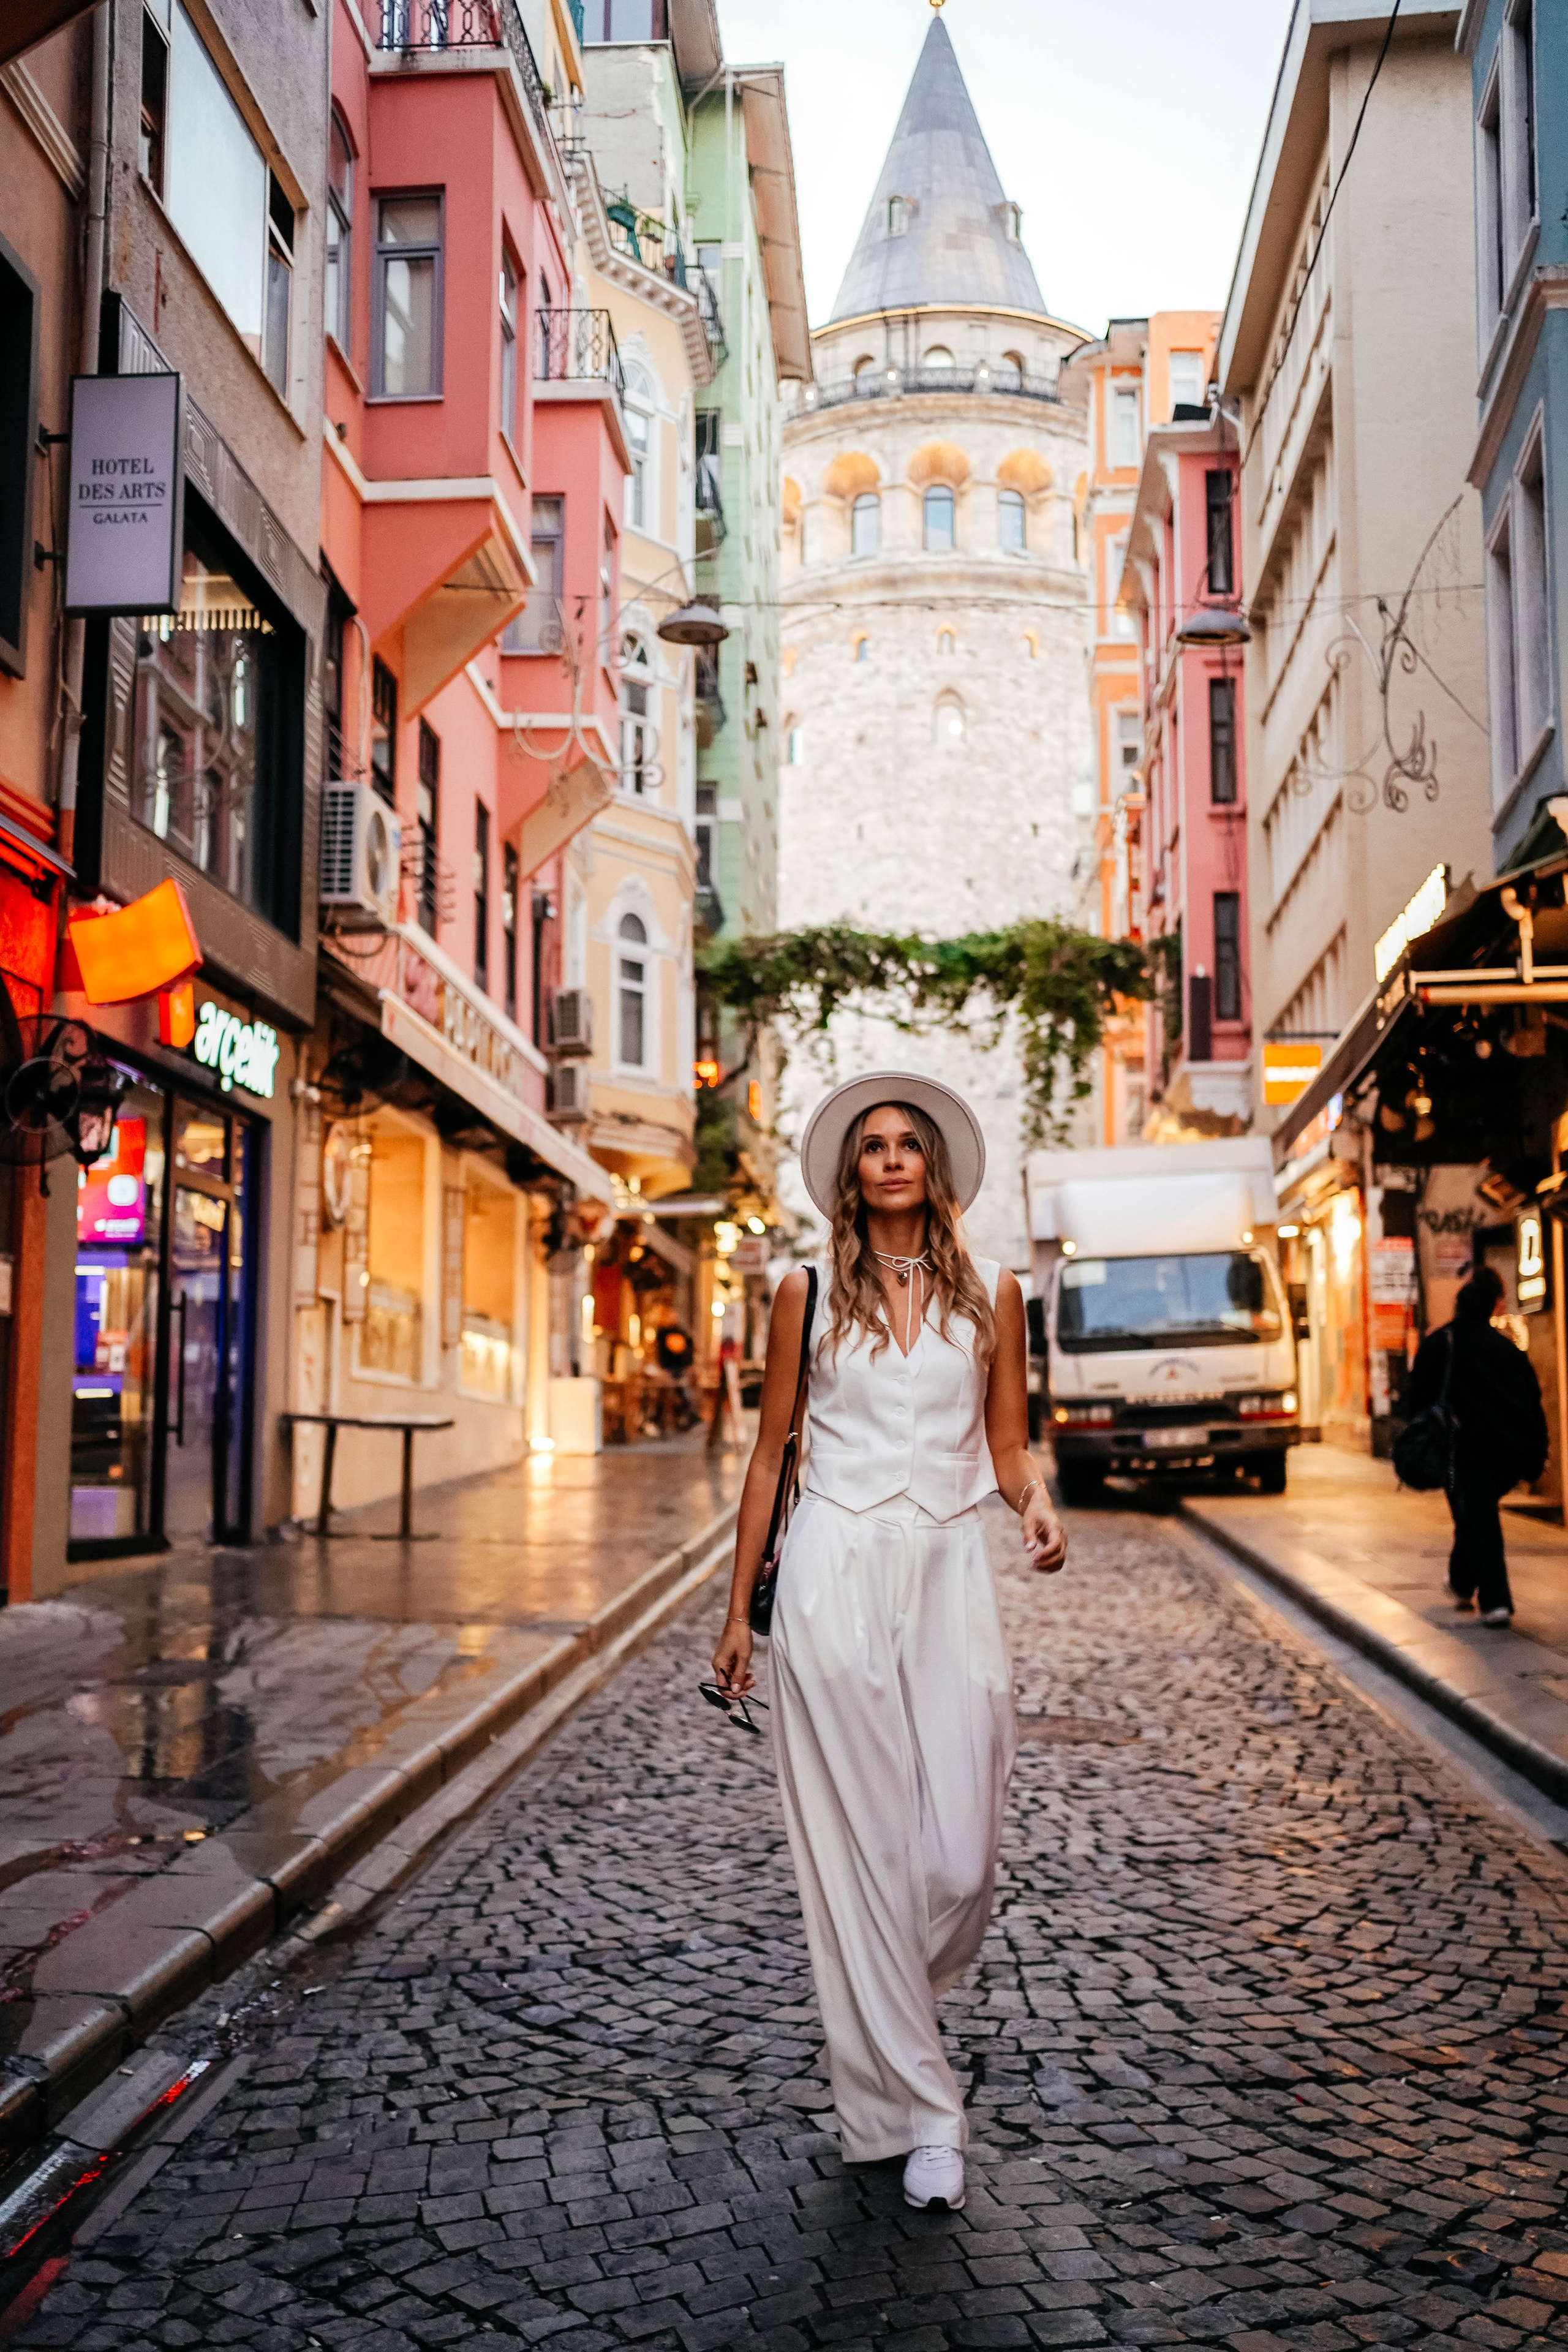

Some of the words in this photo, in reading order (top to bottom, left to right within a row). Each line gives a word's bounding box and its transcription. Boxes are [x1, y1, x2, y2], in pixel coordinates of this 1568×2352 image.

[92, 458, 154, 475] HOTEL
[78, 483, 115, 499] DES
[119, 481, 165, 499] ARTS
[93, 512, 148, 524] GALATA
